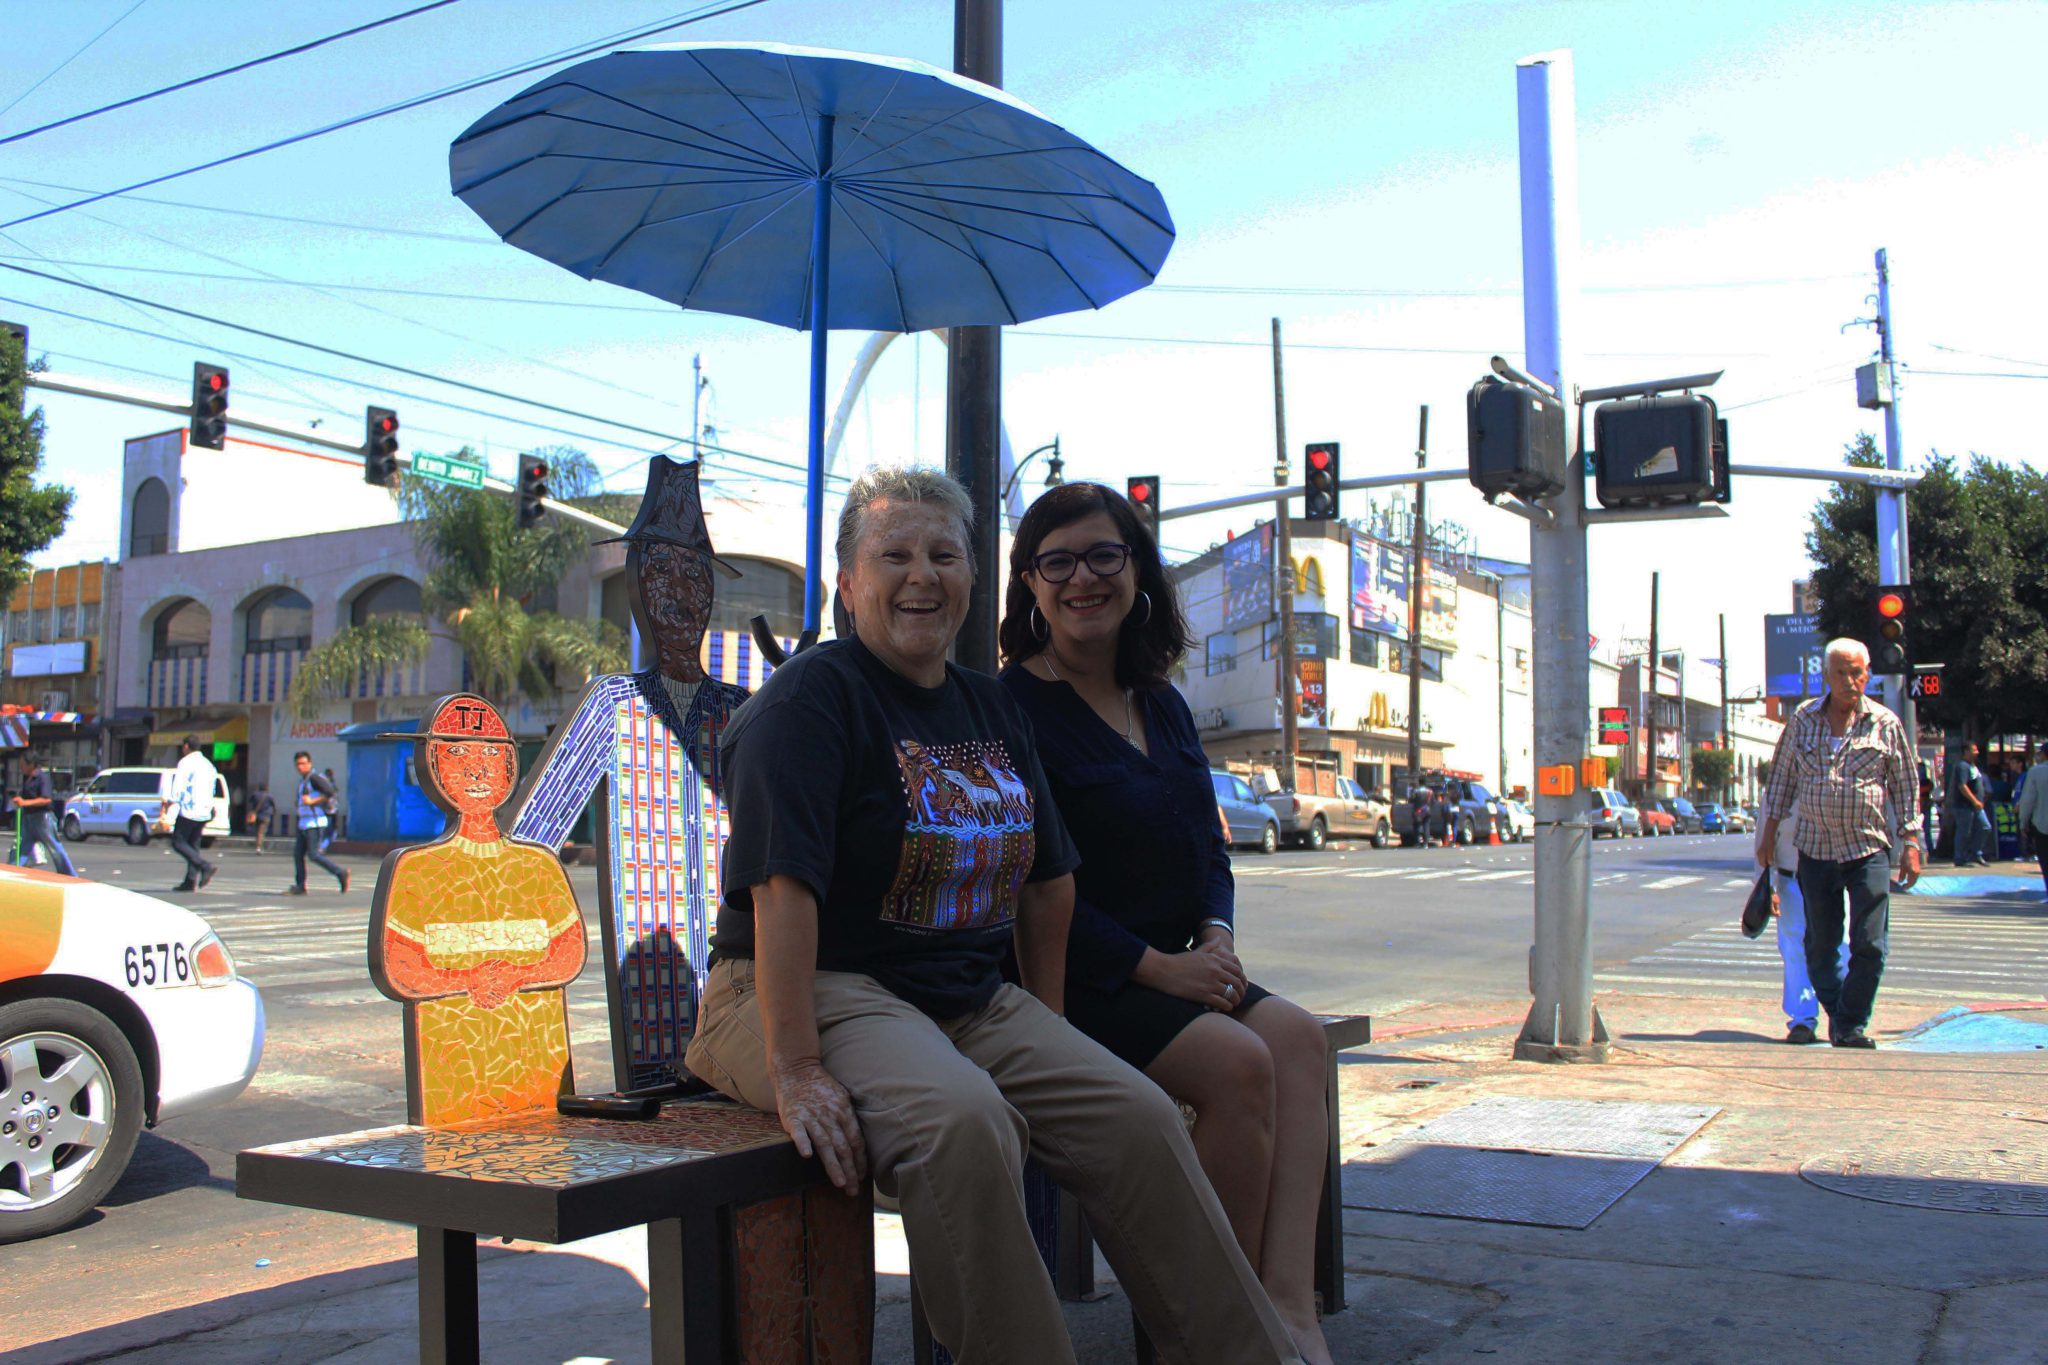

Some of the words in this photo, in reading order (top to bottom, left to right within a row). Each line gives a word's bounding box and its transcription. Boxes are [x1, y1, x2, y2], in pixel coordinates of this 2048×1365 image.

[1924, 674, 1940, 695] 68
[455, 706, 487, 731] TJ
[125, 942, 189, 987] 6576
